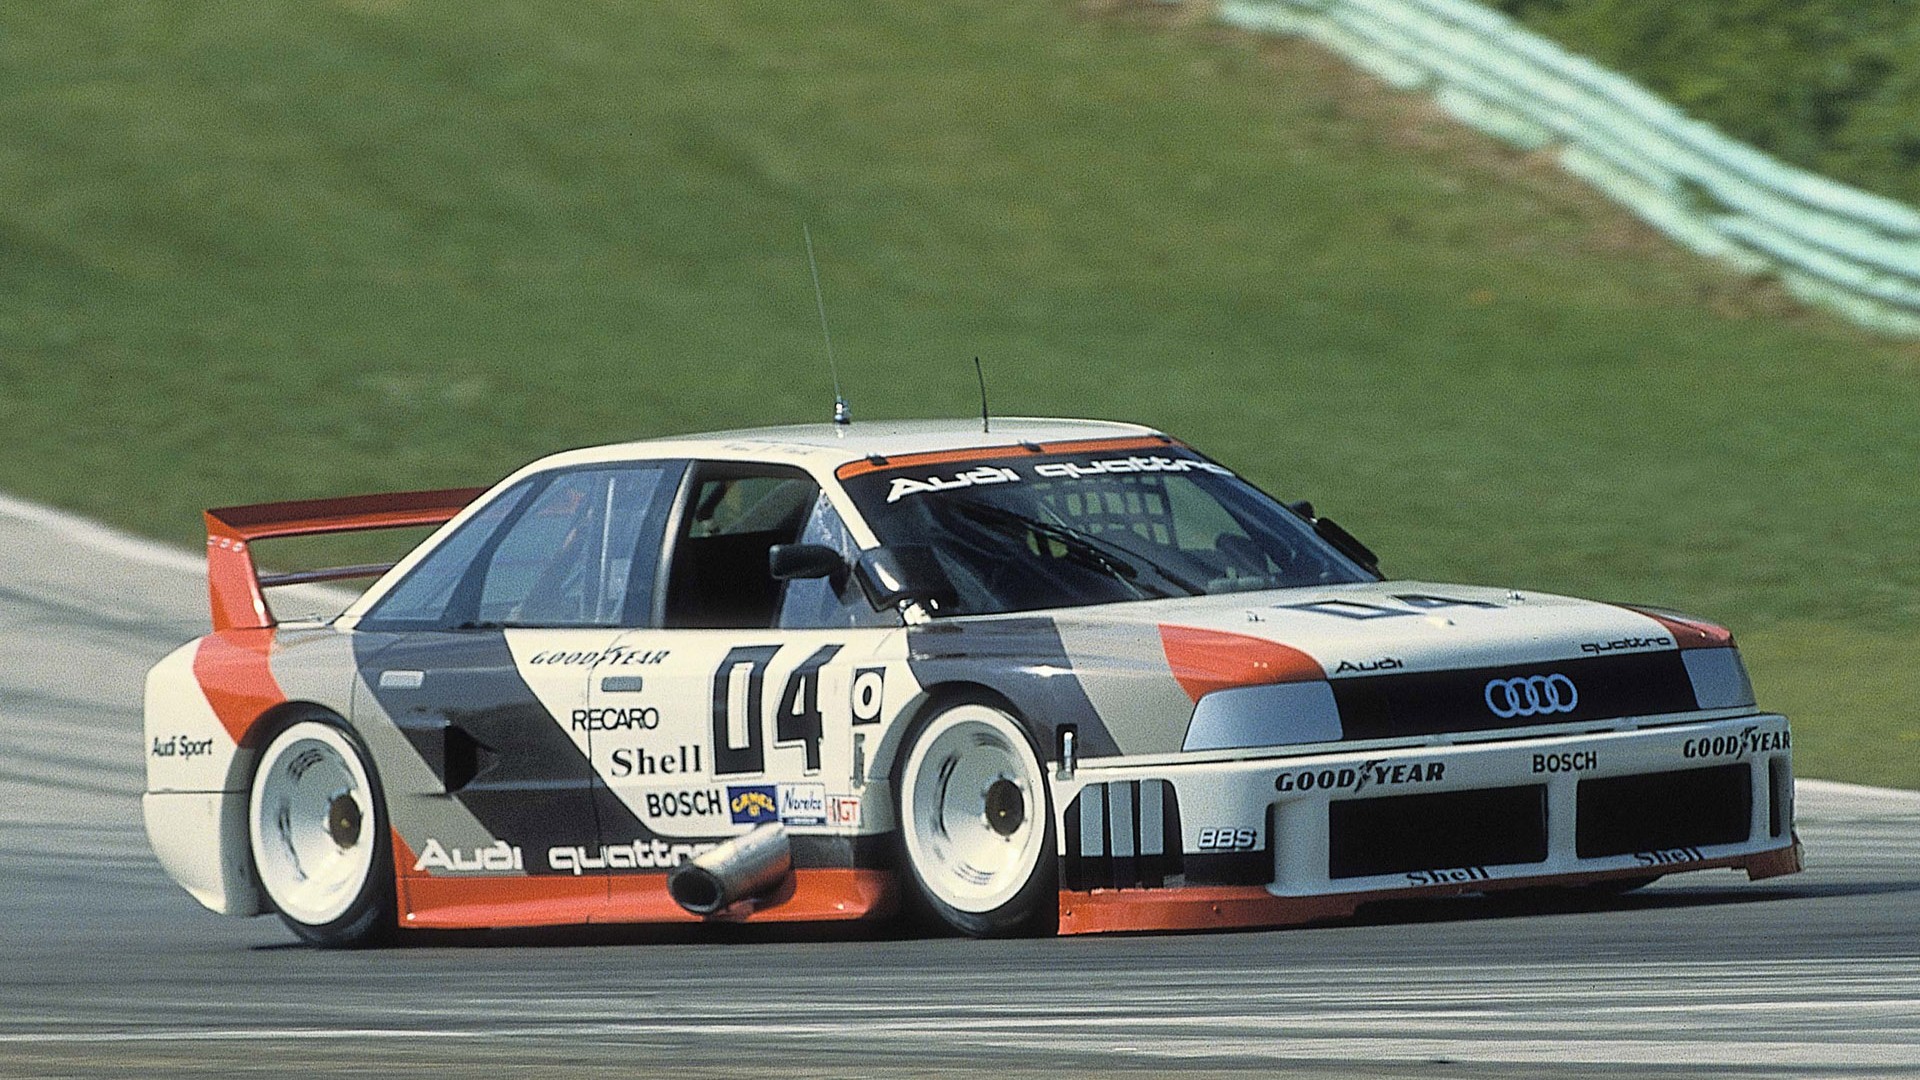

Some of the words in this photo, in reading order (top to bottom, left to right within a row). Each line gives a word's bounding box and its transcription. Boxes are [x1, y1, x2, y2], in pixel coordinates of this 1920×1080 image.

[887, 466, 1020, 502] Audi
[1034, 455, 1235, 479] quattro
[1581, 635, 1671, 653] quattro
[1335, 658, 1404, 674] Audi
[572, 707, 659, 732] RECARO
[712, 643, 845, 776] 04
[152, 735, 176, 756] Audi
[179, 734, 213, 760] Sport
[611, 745, 701, 777] Shell
[1533, 751, 1598, 775] BOSCH
[646, 789, 723, 817] BOSCH
[1198, 828, 1257, 850] BBS
[413, 838, 524, 871] Audi
[1634, 847, 1704, 866] Shell
[1406, 866, 1491, 886] Shell
